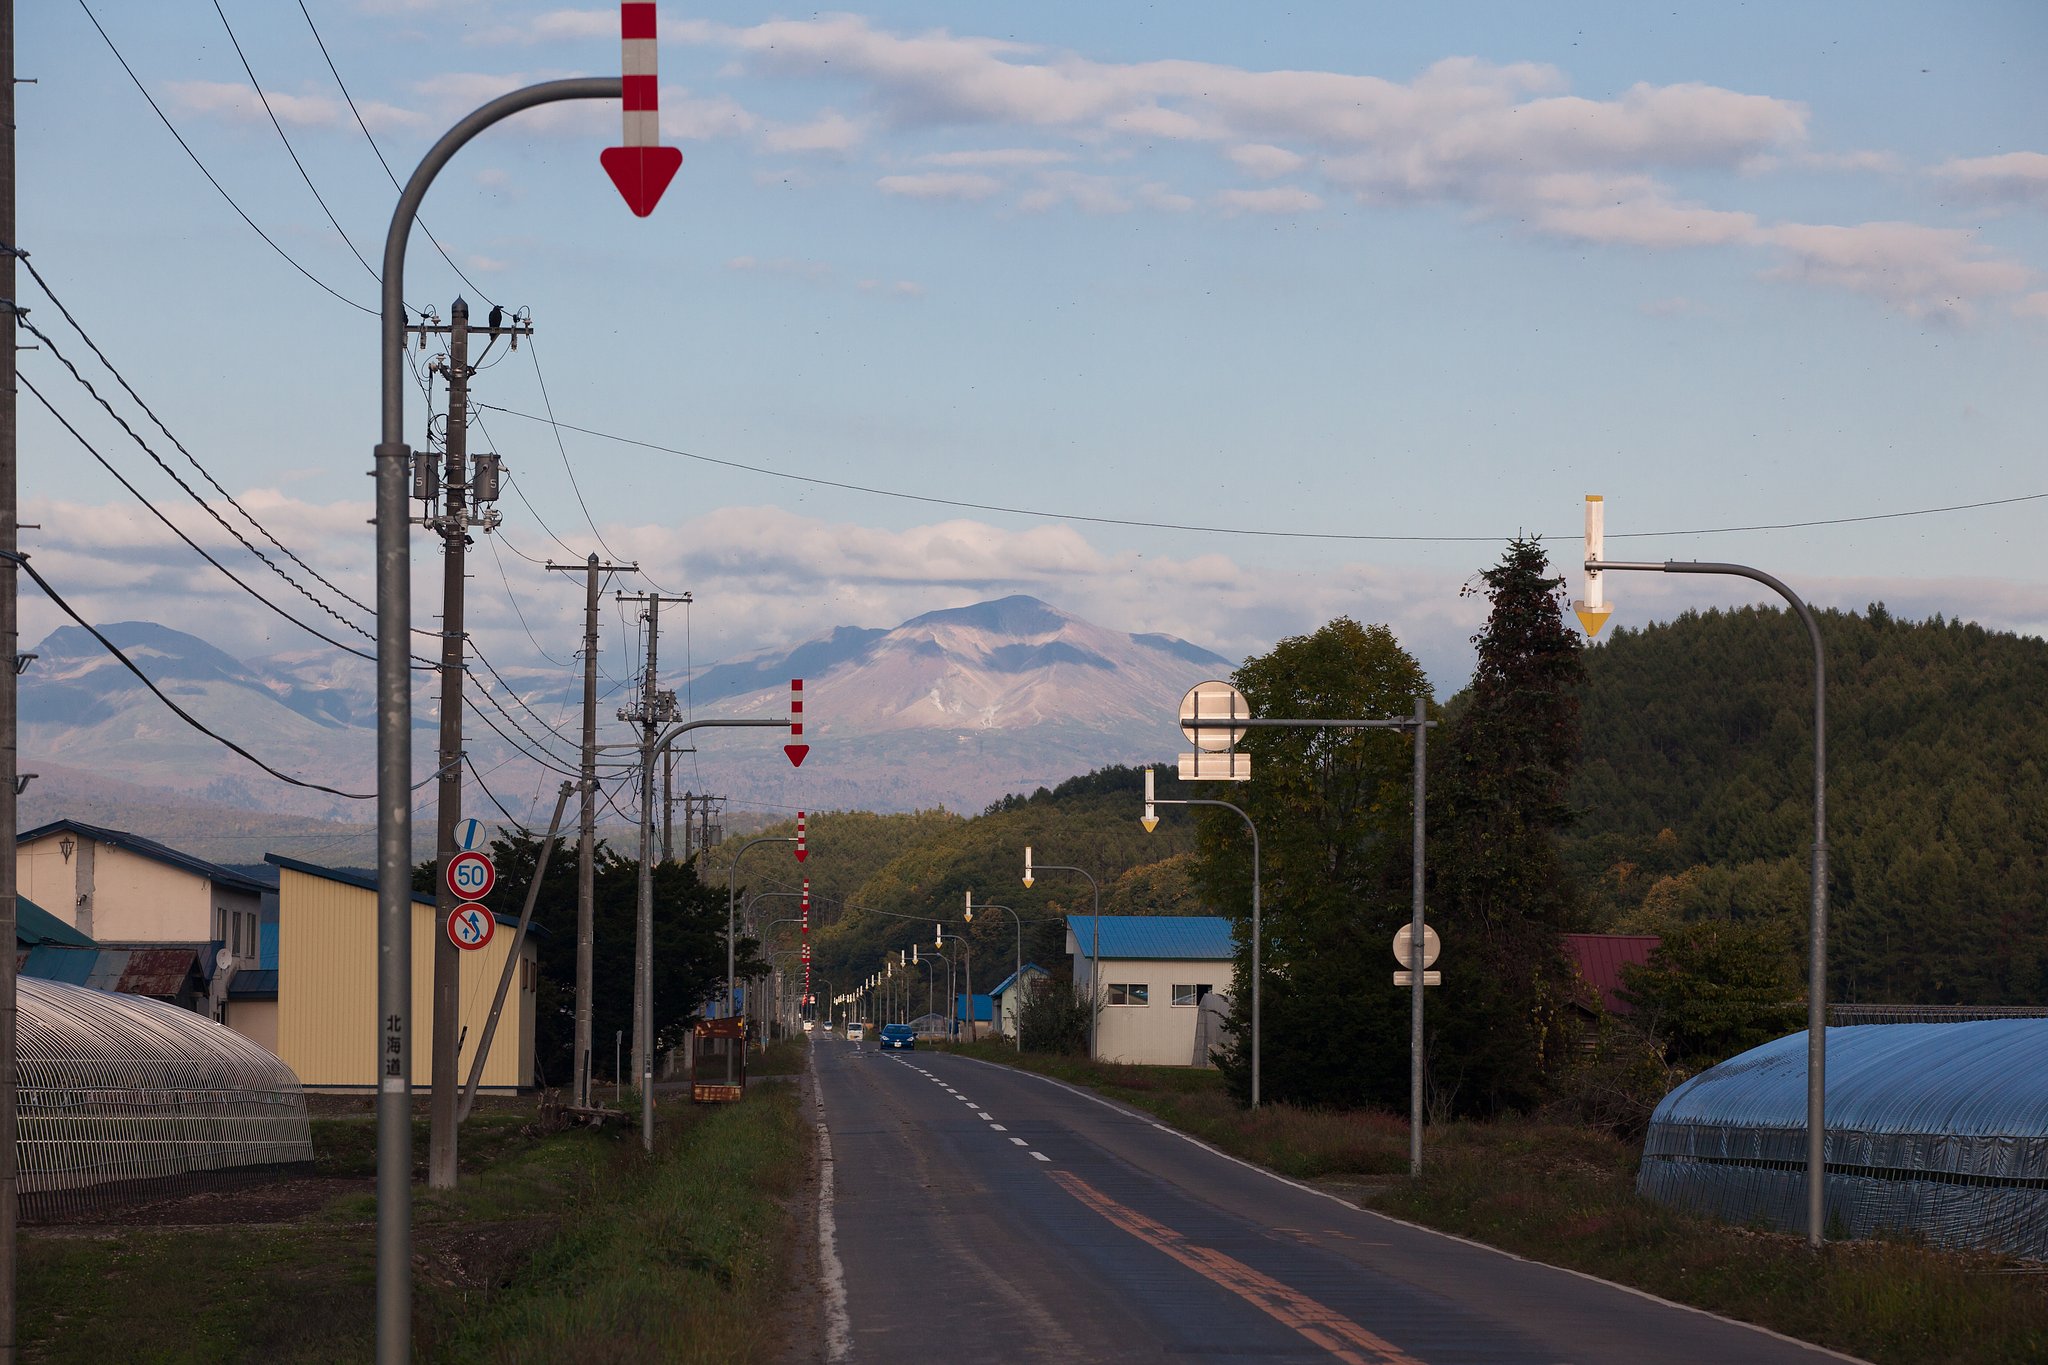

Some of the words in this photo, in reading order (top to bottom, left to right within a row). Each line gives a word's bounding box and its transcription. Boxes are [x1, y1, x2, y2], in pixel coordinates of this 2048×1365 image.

[458, 865, 484, 886] 50
[386, 1014, 402, 1076] 北海道
